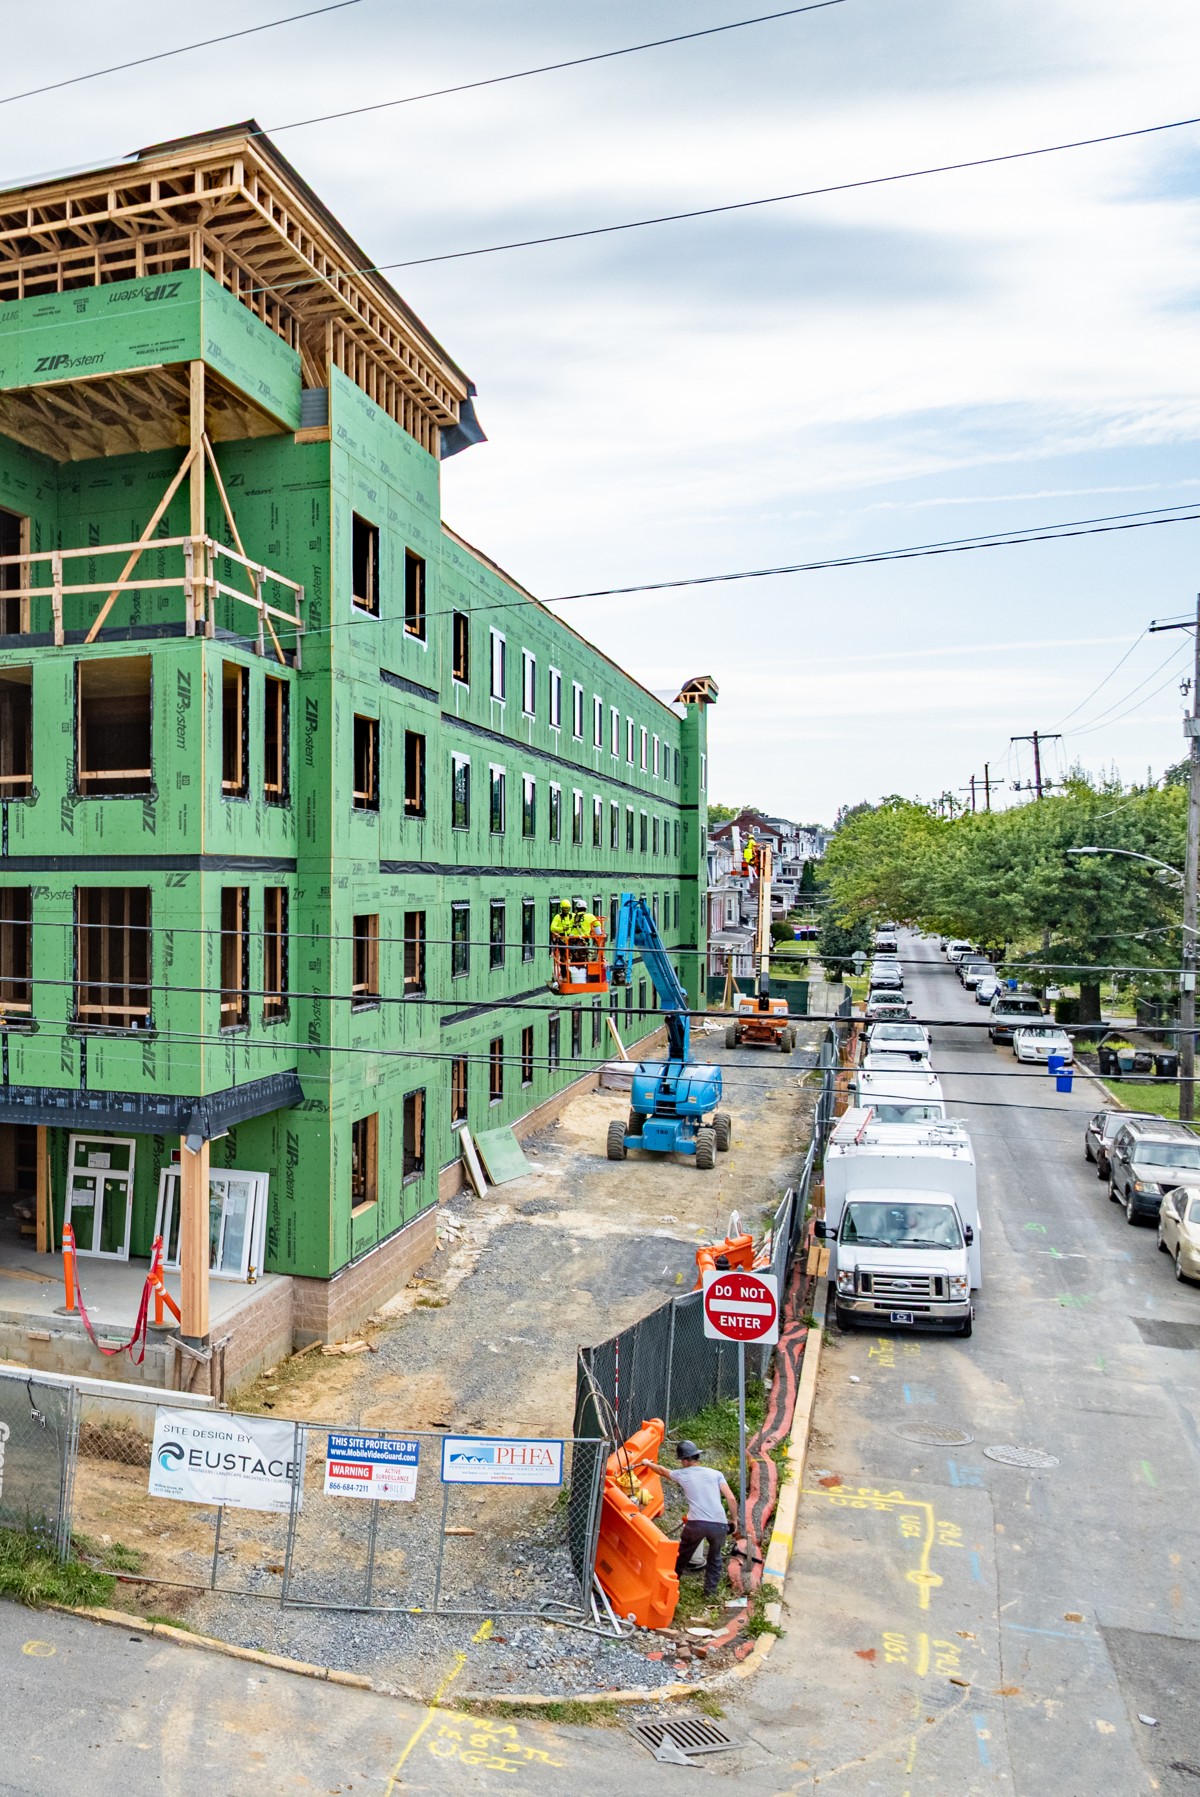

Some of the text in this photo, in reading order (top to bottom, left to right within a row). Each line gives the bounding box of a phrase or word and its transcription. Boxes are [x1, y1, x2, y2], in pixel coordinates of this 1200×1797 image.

[715, 1285, 766, 1300] DO NOT
[720, 1315, 761, 1330] ENTER
[163, 1425, 253, 1443] SITE DESIGN BY
[331, 1436, 417, 1452] THIS SITE PROTECTED BY
[330, 1448, 416, 1462] www.MobileVideoGuard.com
[497, 1447, 554, 1465] PHFA
[189, 1449, 300, 1479] EUSTACE
[332, 1465, 369, 1477] WARNING
[376, 1474, 409, 1482] SURVEILLANCE
[329, 1482, 369, 1492] 866-684-7211
